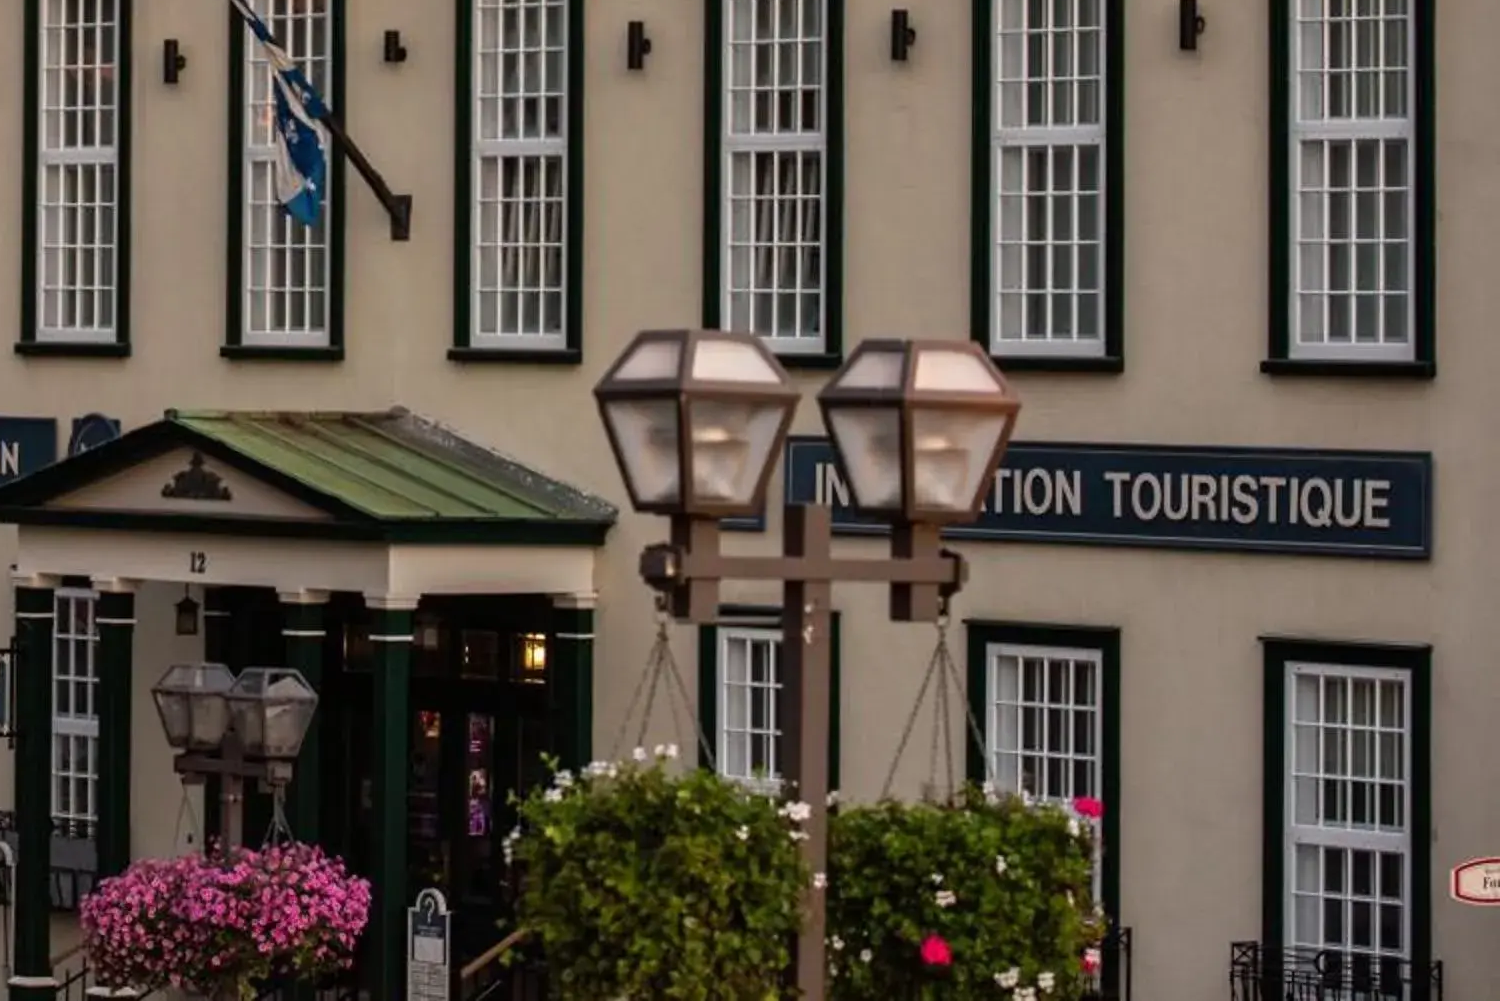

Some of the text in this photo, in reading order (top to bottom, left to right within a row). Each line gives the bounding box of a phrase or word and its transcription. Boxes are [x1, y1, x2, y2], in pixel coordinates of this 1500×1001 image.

[815, 462, 1392, 529] INTION TOURISTIQUE
[189, 550, 207, 575] 12
